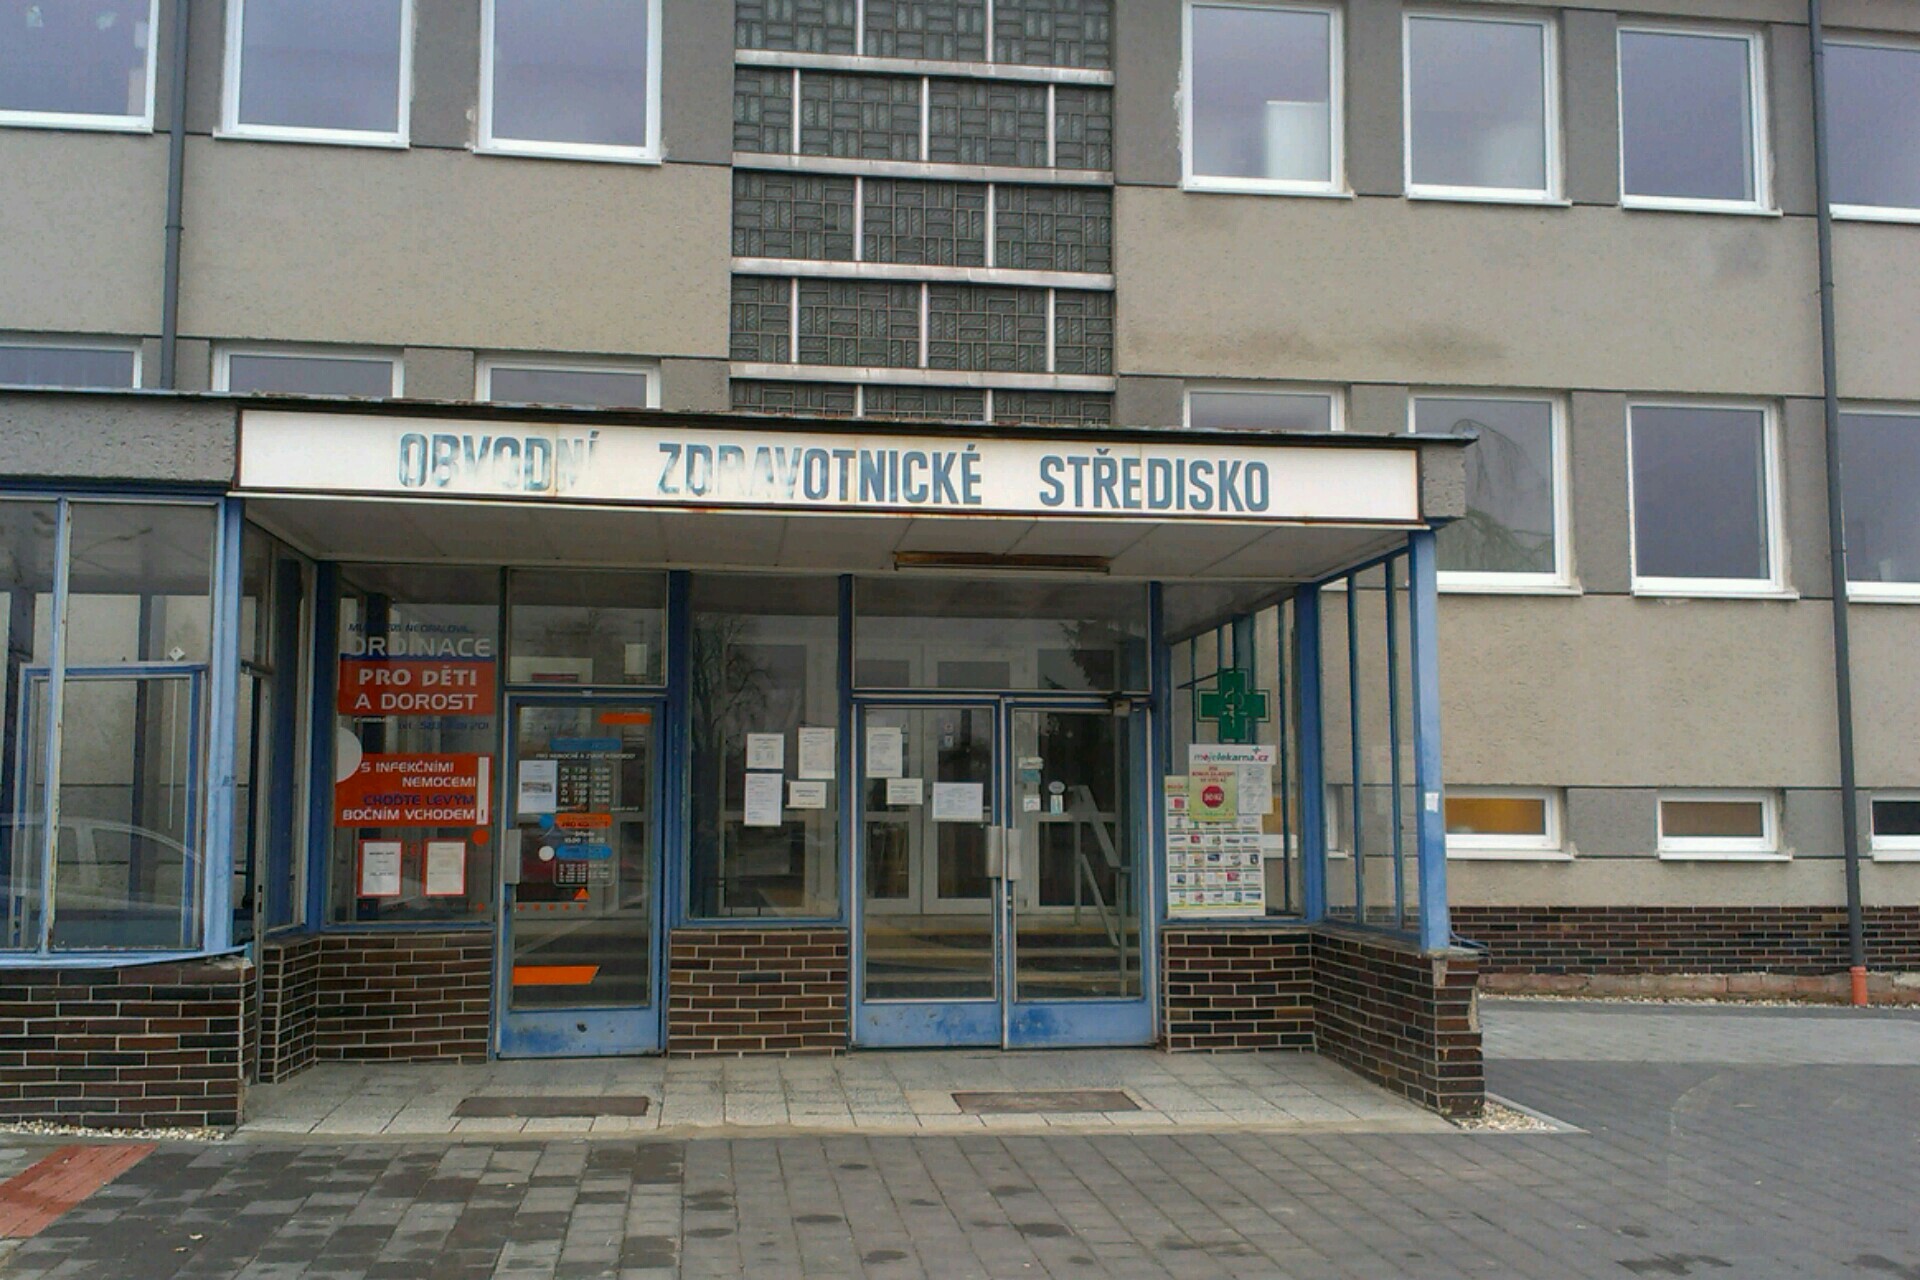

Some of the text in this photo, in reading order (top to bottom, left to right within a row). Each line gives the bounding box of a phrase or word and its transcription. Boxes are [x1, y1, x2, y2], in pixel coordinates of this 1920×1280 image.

[398, 431, 1270, 512] OBVODNÍ ZDRAVOTNICKÉ STŘEDISKO
[350, 636, 491, 657] ORDINACE
[359, 664, 478, 687] PRO DĚTI
[355, 693, 478, 710] A DOROST
[360, 760, 454, 773] S INFEKČNÍMI
[402, 776, 476, 788] NEMOCEMI
[427, 793, 475, 806] LEVÝM
[342, 807, 475, 821] BOČNÍM VCHODEM
